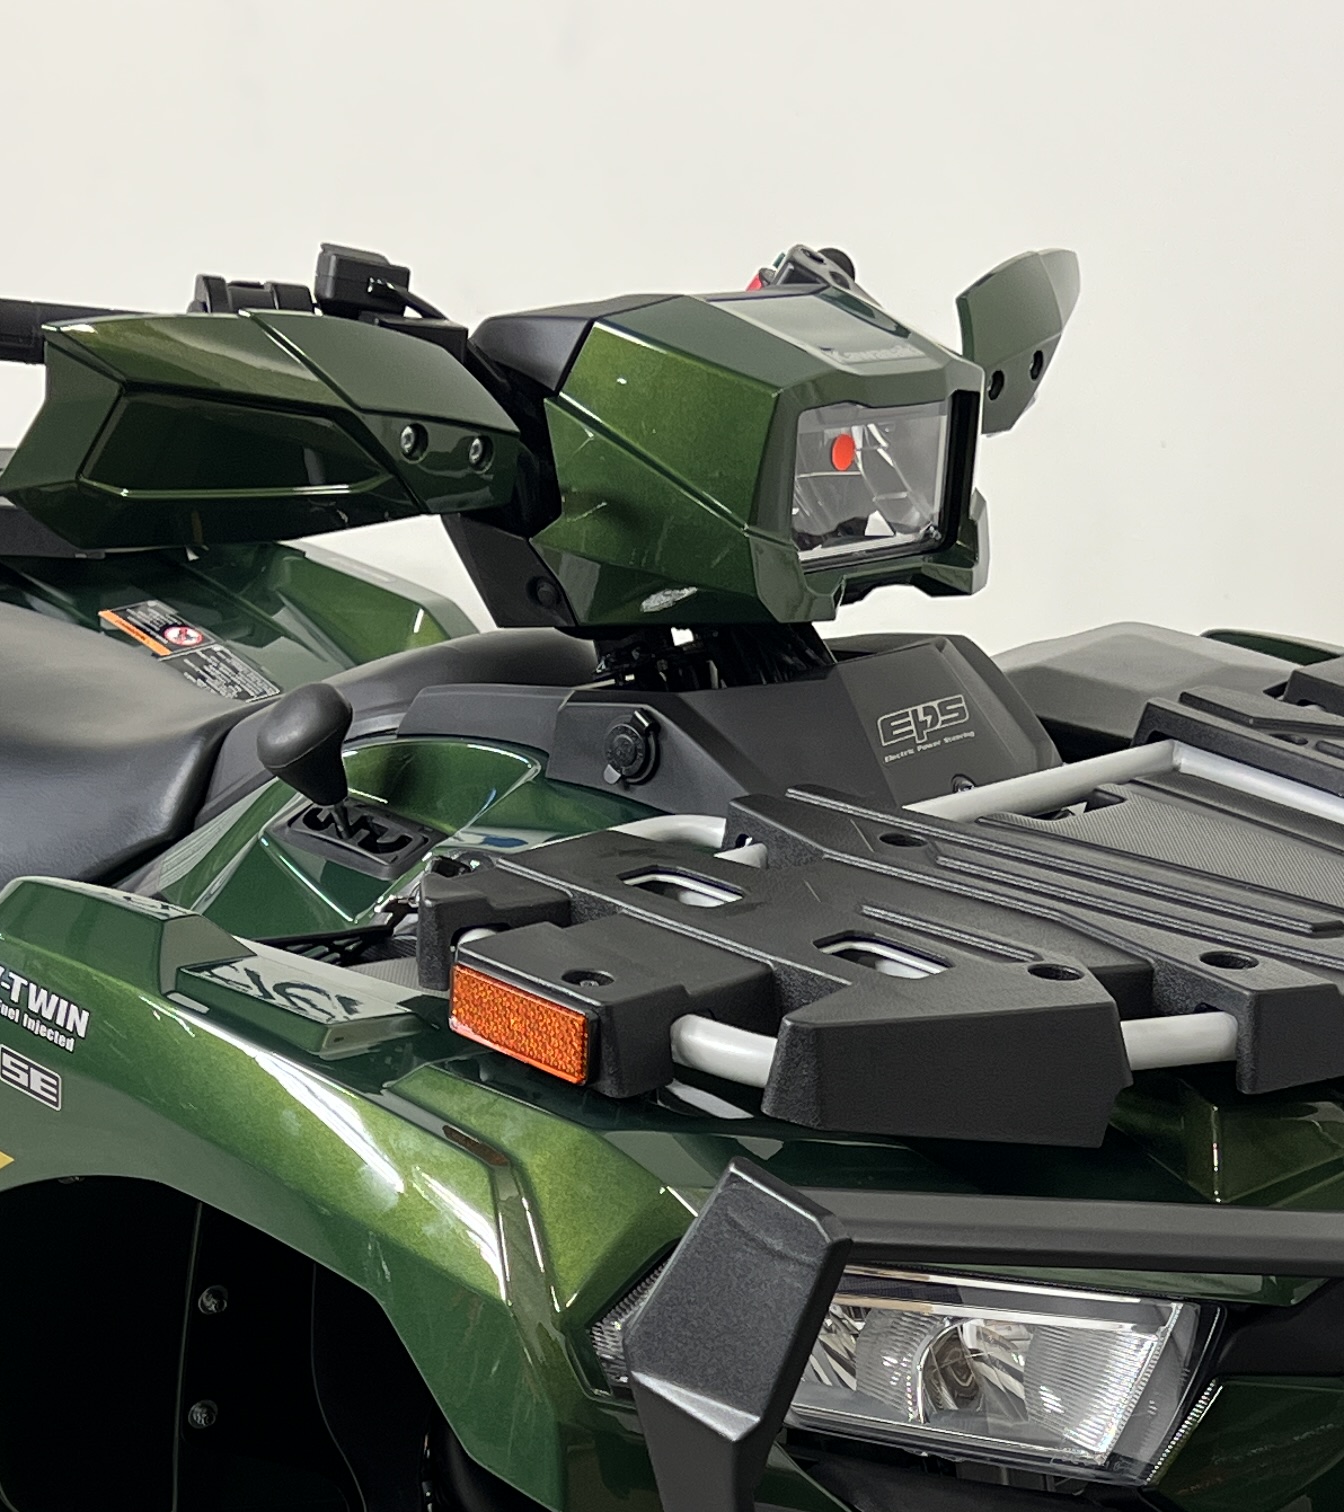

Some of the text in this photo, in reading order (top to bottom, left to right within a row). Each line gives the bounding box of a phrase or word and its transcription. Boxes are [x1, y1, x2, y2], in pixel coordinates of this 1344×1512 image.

[877, 694, 969, 746] EPS
[22, 1013, 75, 1053] Injected
[1, 1052, 58, 1104] SE
